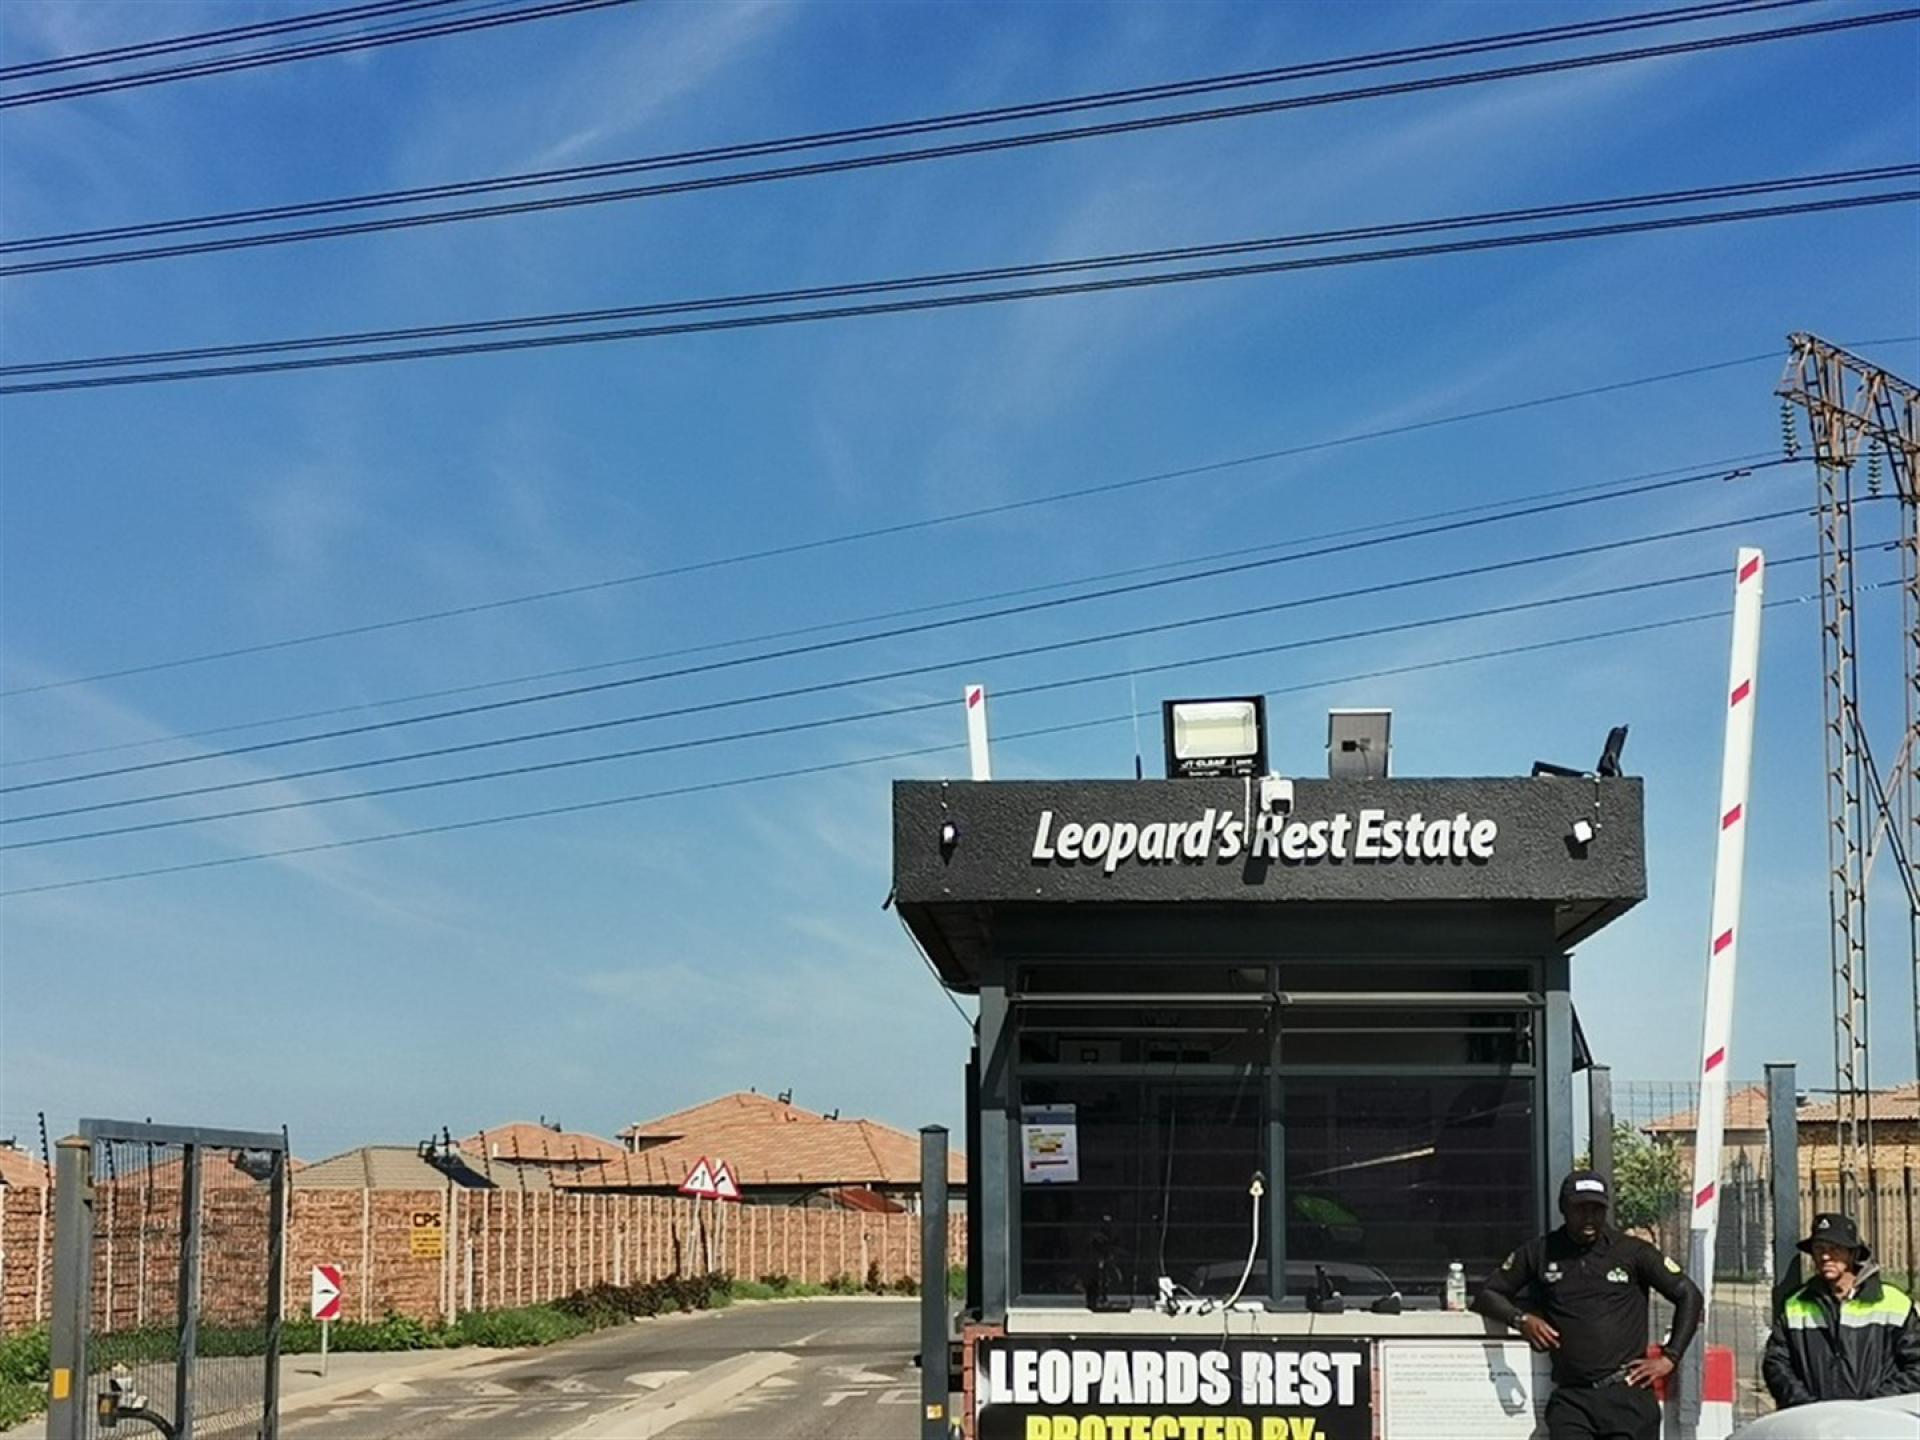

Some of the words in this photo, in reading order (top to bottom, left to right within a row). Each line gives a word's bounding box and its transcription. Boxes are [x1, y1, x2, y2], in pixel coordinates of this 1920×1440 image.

[1252, 812, 1352, 859] Rest
[1355, 809, 1498, 858] Estate
[989, 1349, 1231, 1406] LEOPARDS
[1241, 1351, 1361, 1407] REST
